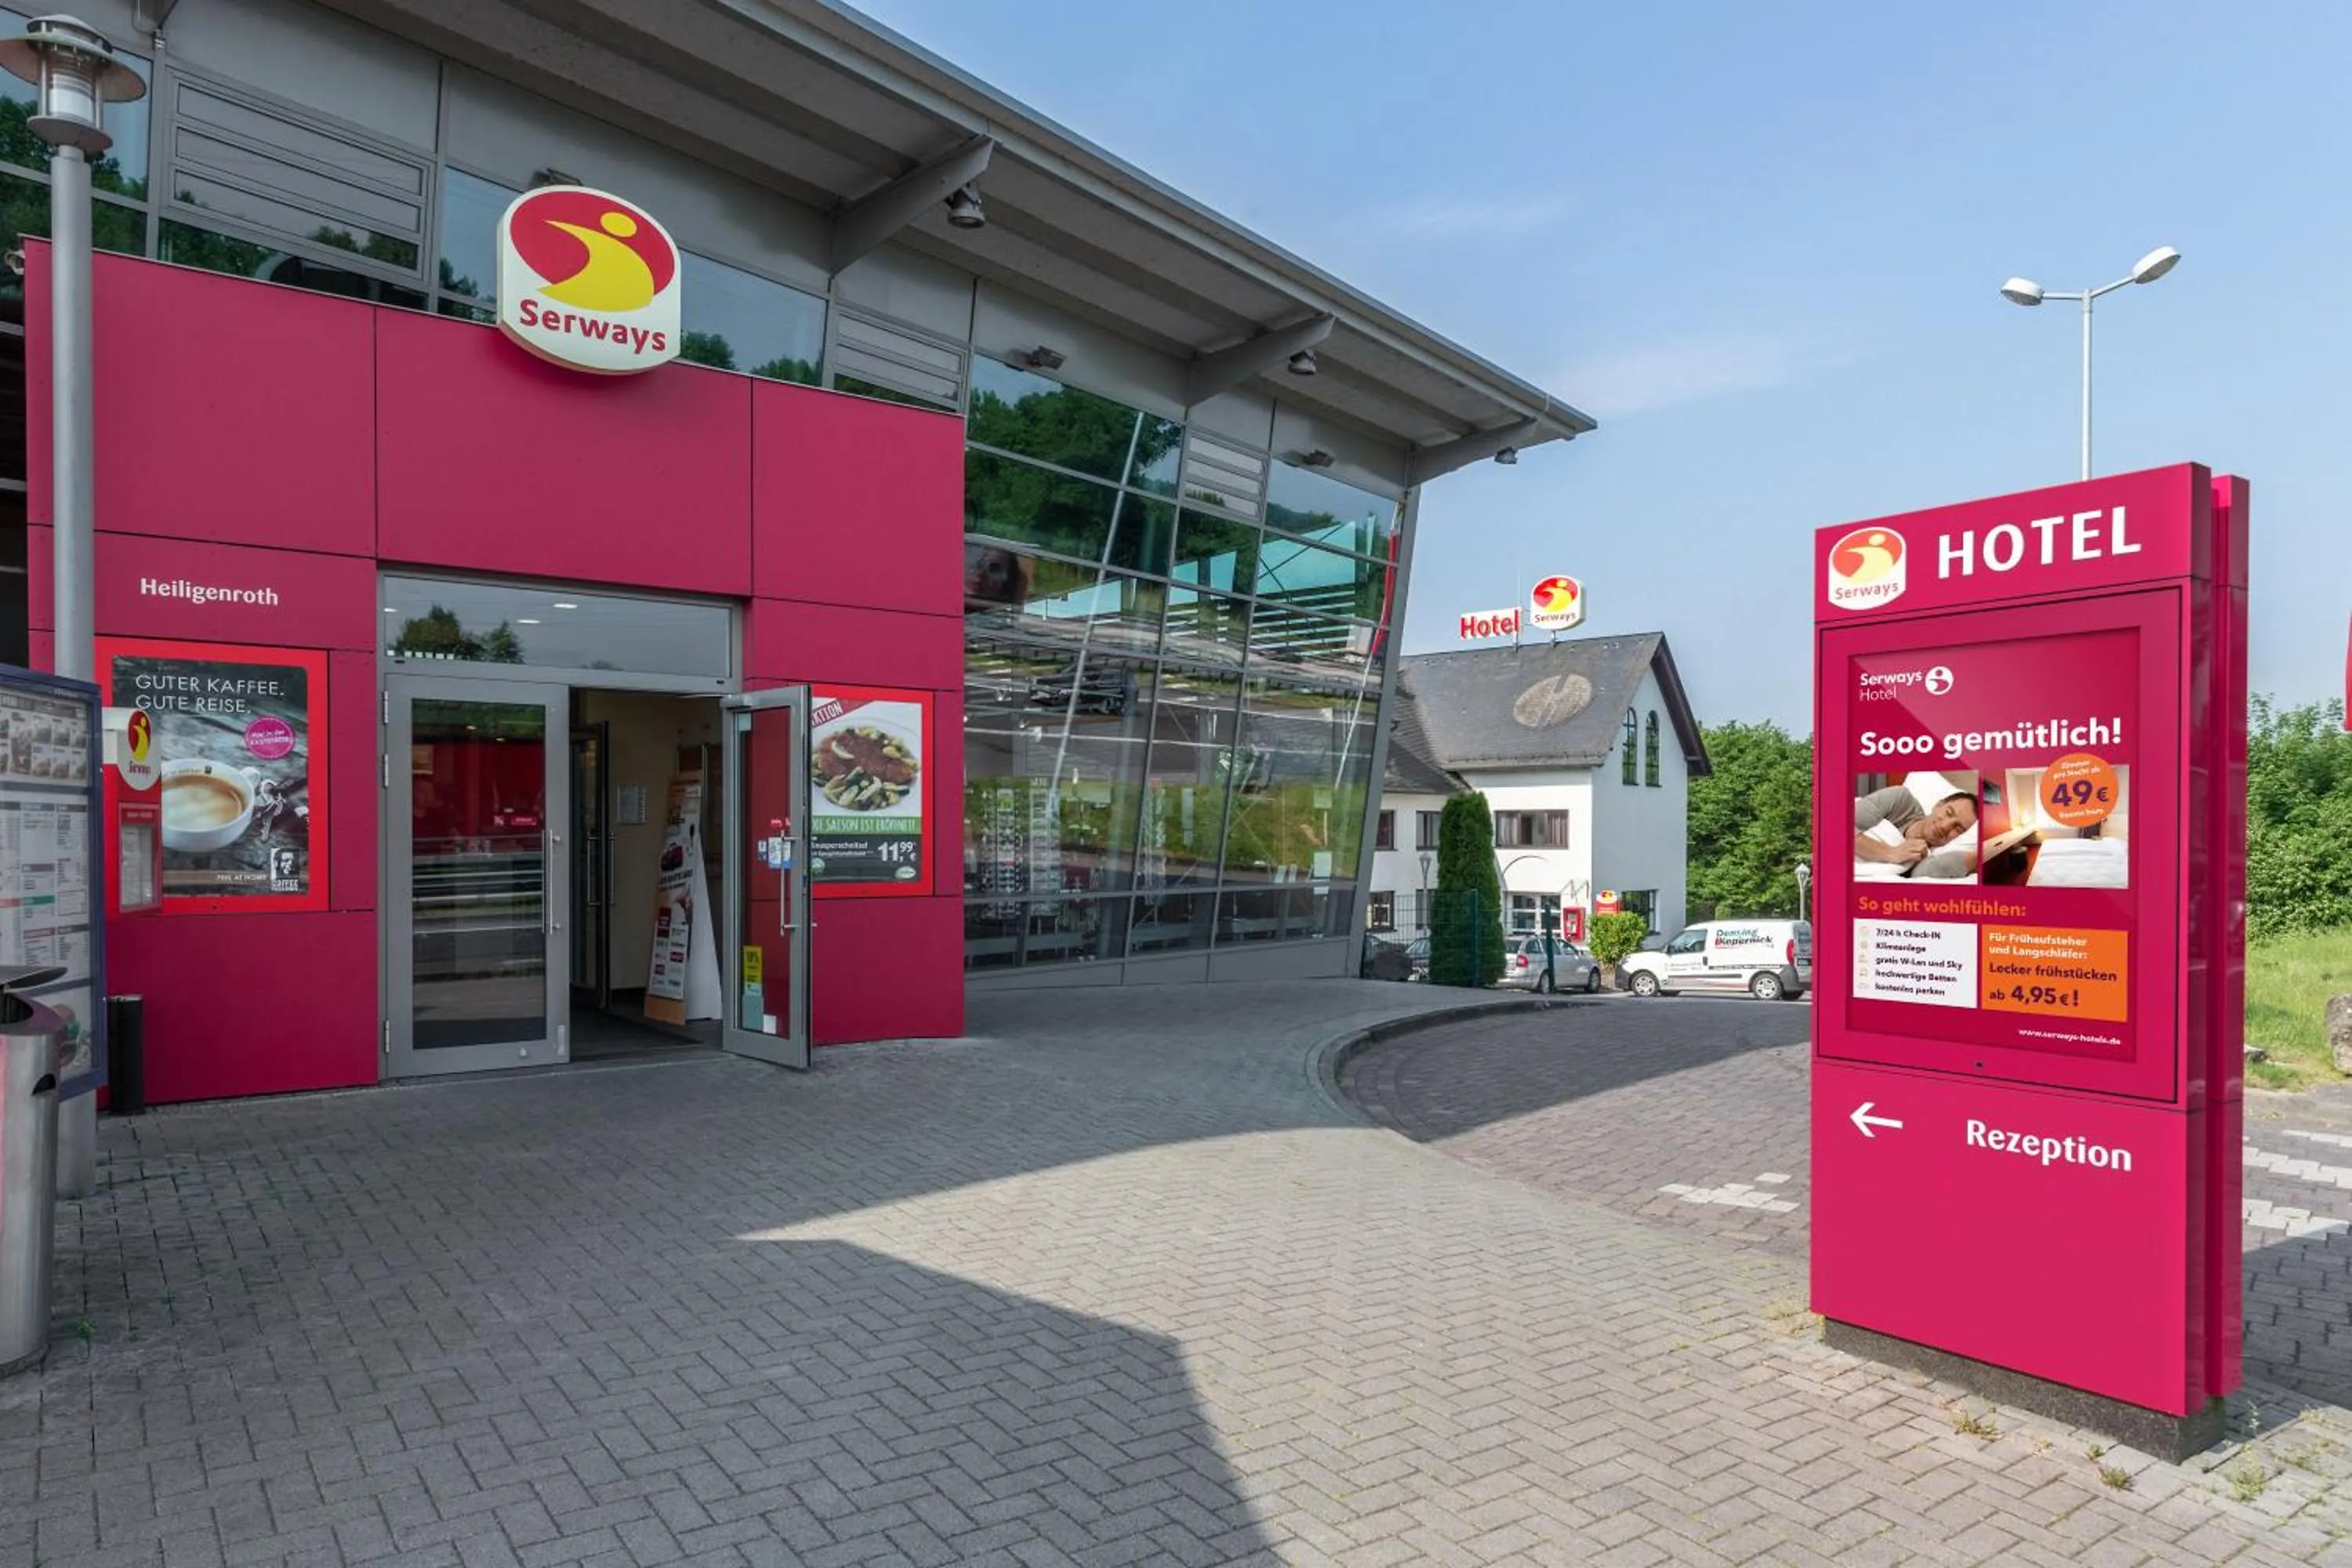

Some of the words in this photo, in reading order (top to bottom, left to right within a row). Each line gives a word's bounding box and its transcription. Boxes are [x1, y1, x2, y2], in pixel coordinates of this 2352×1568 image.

[519, 299, 666, 354] Serways
[1938, 506, 2142, 579] HOTEL
[140, 578, 278, 605] Heiligenroth
[1835, 583, 1898, 600] Serways
[1460, 609, 1519, 639] Hotel
[1534, 612, 1577, 623] Serways
[135, 673, 200, 693] GUTER
[207, 677, 285, 696] KAFFEE.
[1860, 670, 1922, 687] Serways
[1859, 686, 1897, 702] Hotel
[135, 695, 189, 710] GUTE
[196, 695, 252, 715] REISE.
[1860, 731, 1934, 756] Sooo
[1943, 717, 2122, 760] gemütlich!
[2051, 779, 2092, 806] 49
[2096, 786, 2109, 802] €
[1858, 896, 1878, 910] So
[1882, 898, 1920, 915] geht
[1924, 898, 2027, 916] wohlfühlen:
[1988, 931, 2006, 942] Für
[2009, 933, 2088, 946] Frühaufsteher
[1988, 945, 2009, 955] und
[2035, 964, 2118, 982] frühstücken
[1989, 989, 2005, 1000] ab
[2010, 984, 2056, 1005] 4,95
[1965, 1119, 2132, 1172] Rezeption
